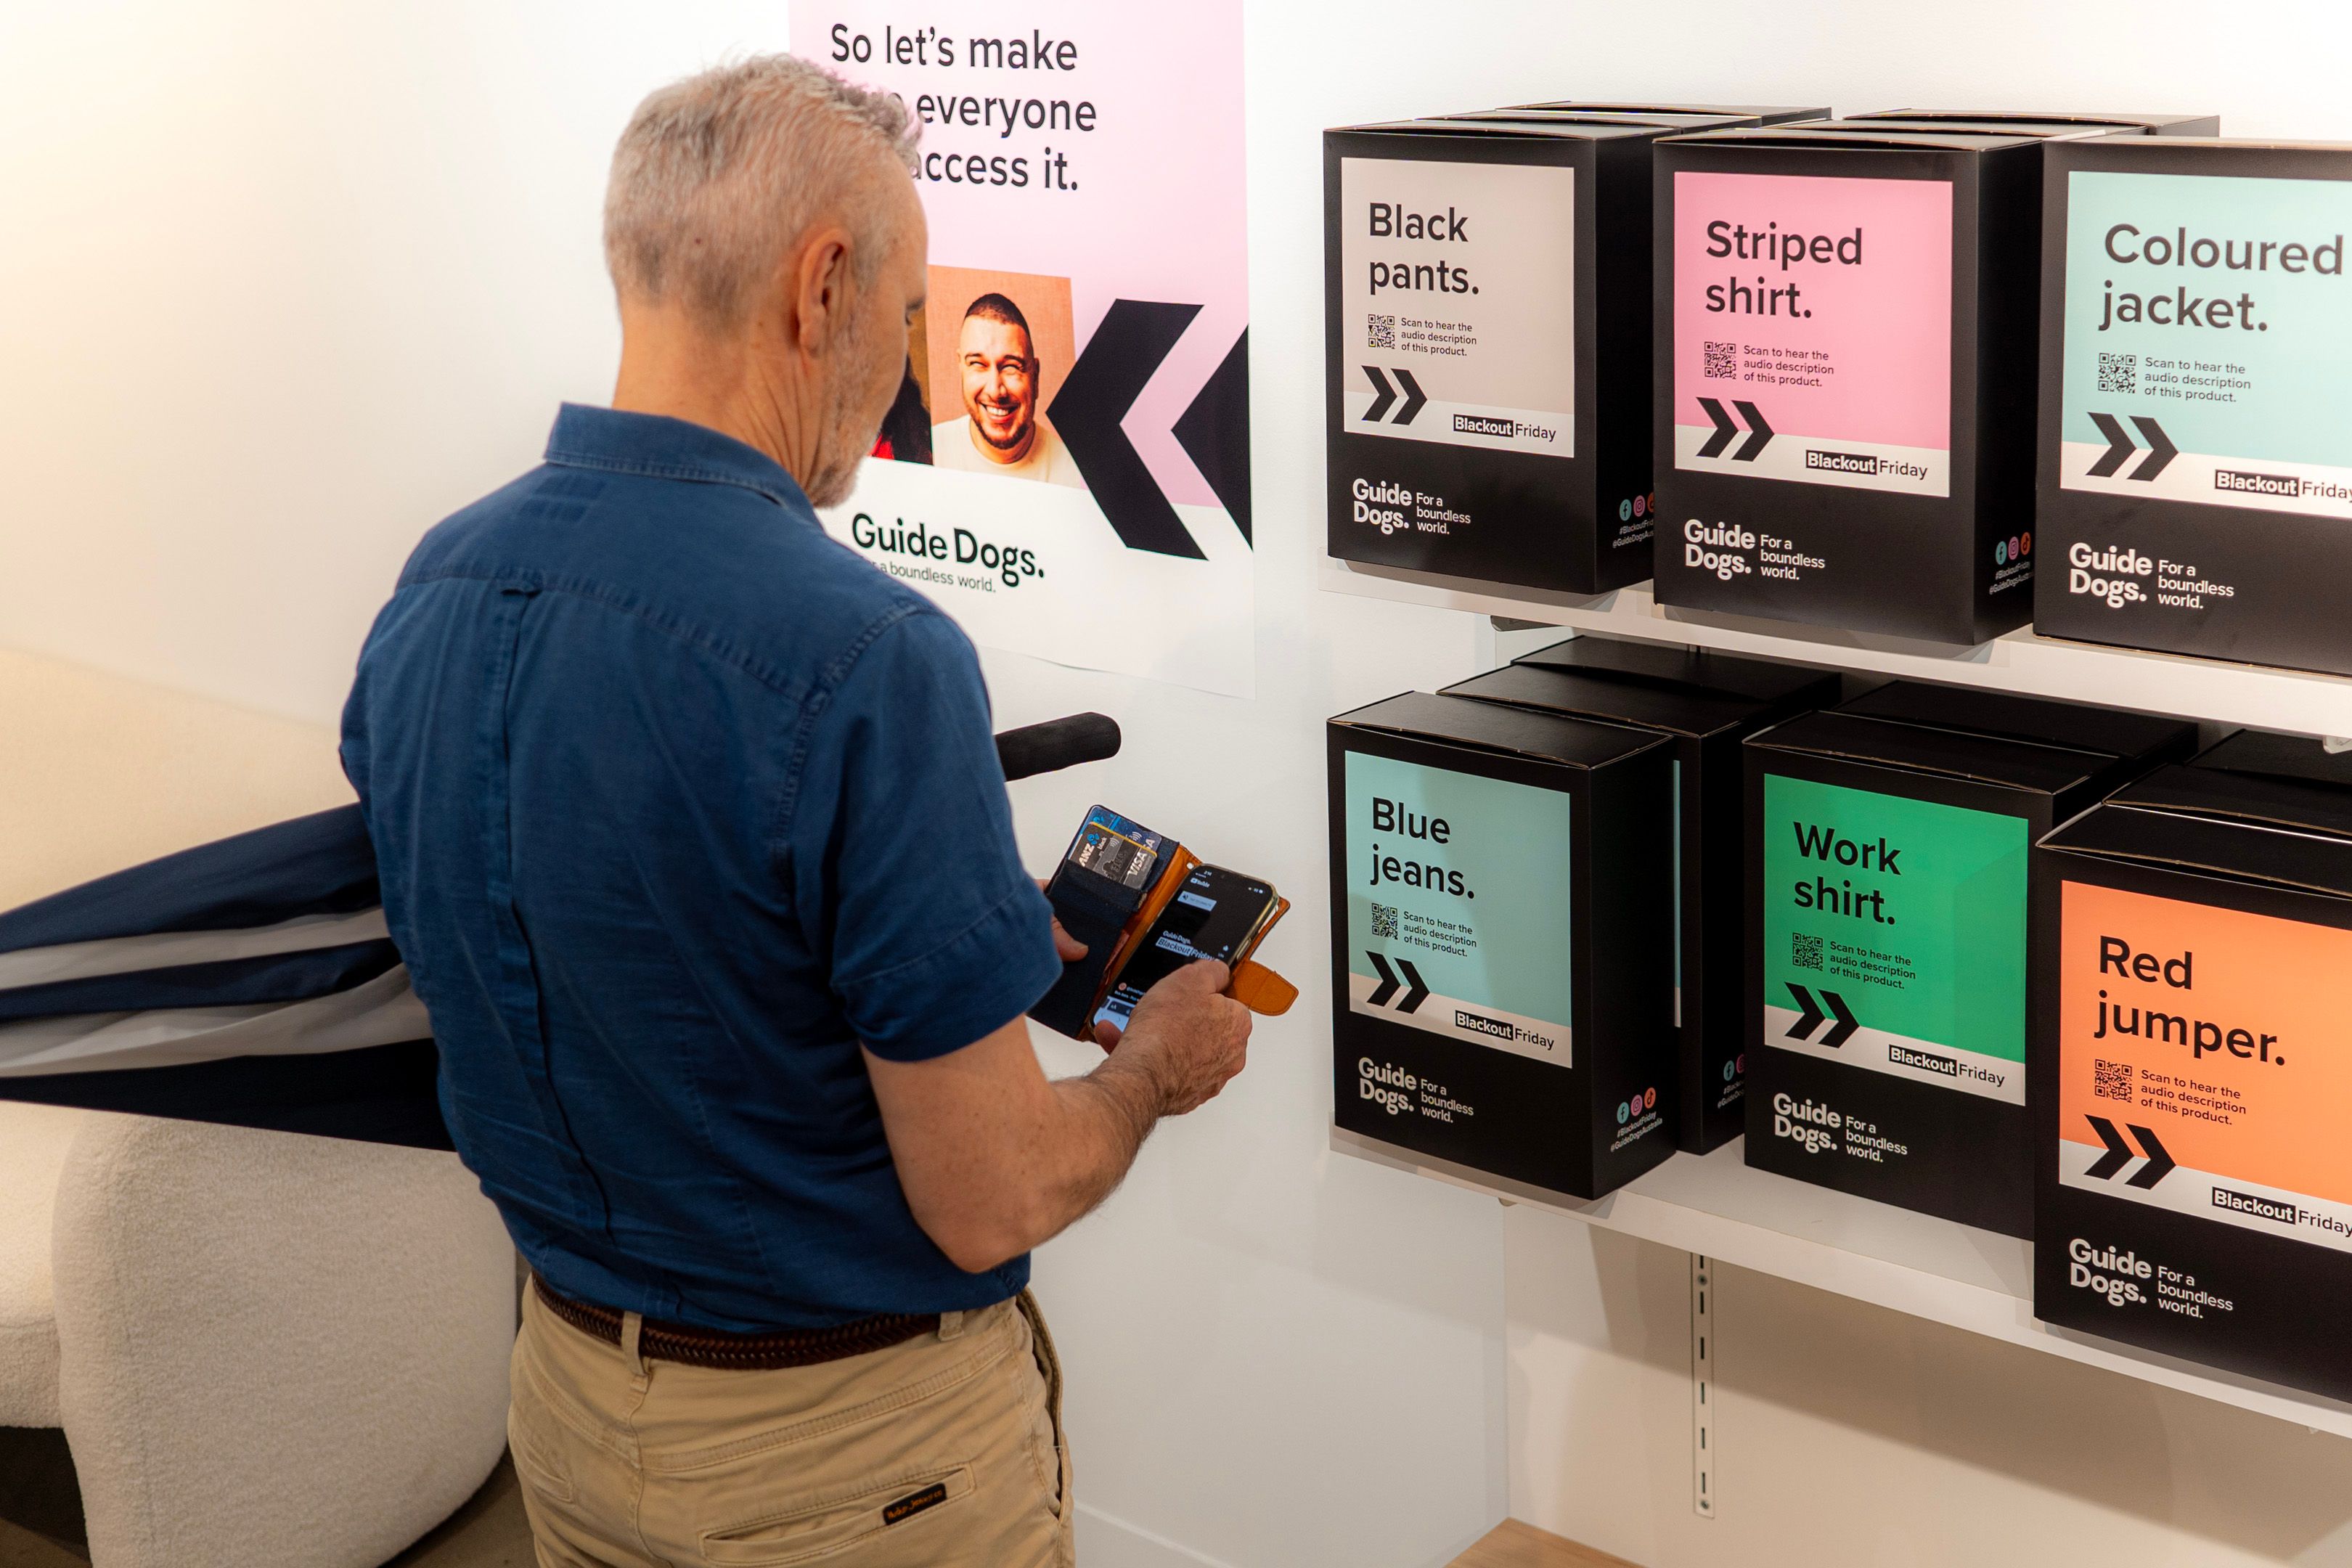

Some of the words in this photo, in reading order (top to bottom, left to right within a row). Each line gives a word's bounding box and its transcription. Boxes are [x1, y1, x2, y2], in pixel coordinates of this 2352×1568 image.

[831, 23, 872, 63] So
[970, 29, 1078, 70] make
[916, 93, 1097, 138] everyone
[1044, 147, 1078, 190] it.
[1369, 203, 1469, 242] Black
[1706, 220, 1863, 270] Striped
[2104, 223, 2345, 275] Coloured
[1369, 259, 1479, 295] pants.
[1705, 276, 1812, 319] shirt.
[2098, 279, 2268, 332] jacket.
[1401, 318, 1422, 330] Scan
[1425, 320, 1434, 331] to
[1436, 321, 1455, 332] hear
[1457, 322, 1473, 332] the
[1401, 330, 1425, 342] audio
[1427, 332, 1477, 346] description
[1401, 343, 1410, 352] of
[1411, 343, 1427, 353] this
[1429, 344, 1467, 357] product.
[1744, 345, 1769, 358] Scan
[1771, 347, 1782, 359] to
[1786, 347, 1809, 359] hear
[1811, 348, 1829, 361] the
[1744, 358, 1773, 372] audio
[1776, 359, 1834, 375] description
[1744, 371, 1755, 383] of
[1757, 371, 1776, 385] this
[1779, 373, 1823, 388] product.
[2145, 357, 2175, 371] Scan
[2178, 359, 2191, 372] to
[2194, 359, 2220, 372] hear
[2223, 362, 2245, 375] the
[2144, 370, 2179, 385] audio
[2182, 372, 2252, 391] description
[2144, 385, 2157, 398] of
[2160, 385, 2182, 399] this
[2186, 388, 2237, 404] product.
[1454, 417, 1512, 436] Blackout
[1515, 424, 1556, 441] Friday
[1807, 452, 1876, 475] Blackout
[1879, 459, 1928, 480] Friday
[1352, 478, 1412, 505] Guide
[2216, 471, 2298, 496] Blackout
[1416, 492, 1432, 505] For
[1436, 497, 1443, 507] a
[1353, 501, 1410, 534] Dogs.
[1416, 505, 1471, 524] boundless
[1416, 520, 1450, 535] world.
[1684, 518, 1755, 550] Guide
[1760, 534, 1781, 548] For
[1784, 538, 1792, 550] a
[852, 513, 947, 560] Guide
[954, 528, 1045, 588] Dogs.
[1685, 544, 1752, 581] Dogs.
[1760, 549, 1825, 568] boundless
[2069, 542, 2153, 576] Guide
[890, 562, 954, 584] boundless
[958, 576, 996, 592] world.
[1760, 565, 1800, 581] world.
[2158, 560, 2184, 576] For
[2186, 565, 2196, 576] a
[2070, 568, 2147, 608] Dogs.
[2158, 575, 2234, 597] boundless
[2158, 593, 2203, 609] world.
[1372, 797, 1451, 844] Blue
[1793, 822, 1902, 875] Work
[1128, 852, 1146, 875] VISA
[1370, 844, 1475, 899] jeans.
[1793, 876, 1896, 926] shirt.
[1403, 910, 1424, 925] Scan
[1426, 915, 1435, 926] to
[1437, 917, 1457, 929] hear
[1458, 920, 1473, 934] the
[1403, 923, 1427, 936] audio
[1429, 927, 1477, 948] description
[1159, 939, 1191, 954] Blackout
[1404, 935, 1413, 944] of
[1415, 936, 1431, 950] this
[1432, 940, 1468, 957] product.
[1830, 940, 1854, 955] Scan
[1856, 945, 1866, 957] to
[1870, 948, 1892, 963] hear
[1895, 952, 1911, 967] the
[1830, 953, 1858, 968] audio
[1861, 958, 1916, 981] description
[2099, 935, 2193, 989] Red
[1830, 965, 1841, 976] of
[1842, 968, 1861, 981] this
[1863, 973, 1905, 991] product.
[1456, 1011, 1512, 1038] Blackout
[1515, 1028, 1554, 1050] Friday
[2094, 989, 2286, 1066] jumper.
[1358, 1056, 1417, 1090] Guide
[1890, 1046, 1956, 1075] Blackout
[1959, 1063, 2006, 1087] Friday
[1359, 1078, 1414, 1114] Dogs.
[1421, 1078, 1437, 1093] For
[1440, 1085, 1447, 1095] a
[2141, 1070, 2171, 1085] Scan
[2173, 1075, 2186, 1088] to
[2189, 1077, 2217, 1095] hear
[2221, 1085, 2242, 1100] the
[1421, 1093, 1474, 1116] boundless
[1773, 1093, 1841, 1128] Guide
[2141, 1084, 2175, 1100] audio
[2179, 1090, 2247, 1116] description
[2141, 1097, 2155, 1111] of
[2157, 1099, 2178, 1114] this
[2182, 1105, 2233, 1126] product.
[1421, 1106, 1453, 1123] world.
[1846, 1116, 1866, 1132] For
[1869, 1122, 1877, 1134] a
[1773, 1114, 1837, 1154] Dogs.
[1846, 1130, 1908, 1156] boundless
[1846, 1143, 1884, 1164] world.
[2213, 1189, 2295, 1222] Blackout
[2069, 1237, 2152, 1279] Guide
[2070, 1261, 2147, 1307] Dogs.
[2158, 1265, 2183, 1283] For
[2186, 1273, 2195, 1287] a
[2157, 1281, 2234, 1311] boundless
[2158, 1297, 2203, 1320] world.
